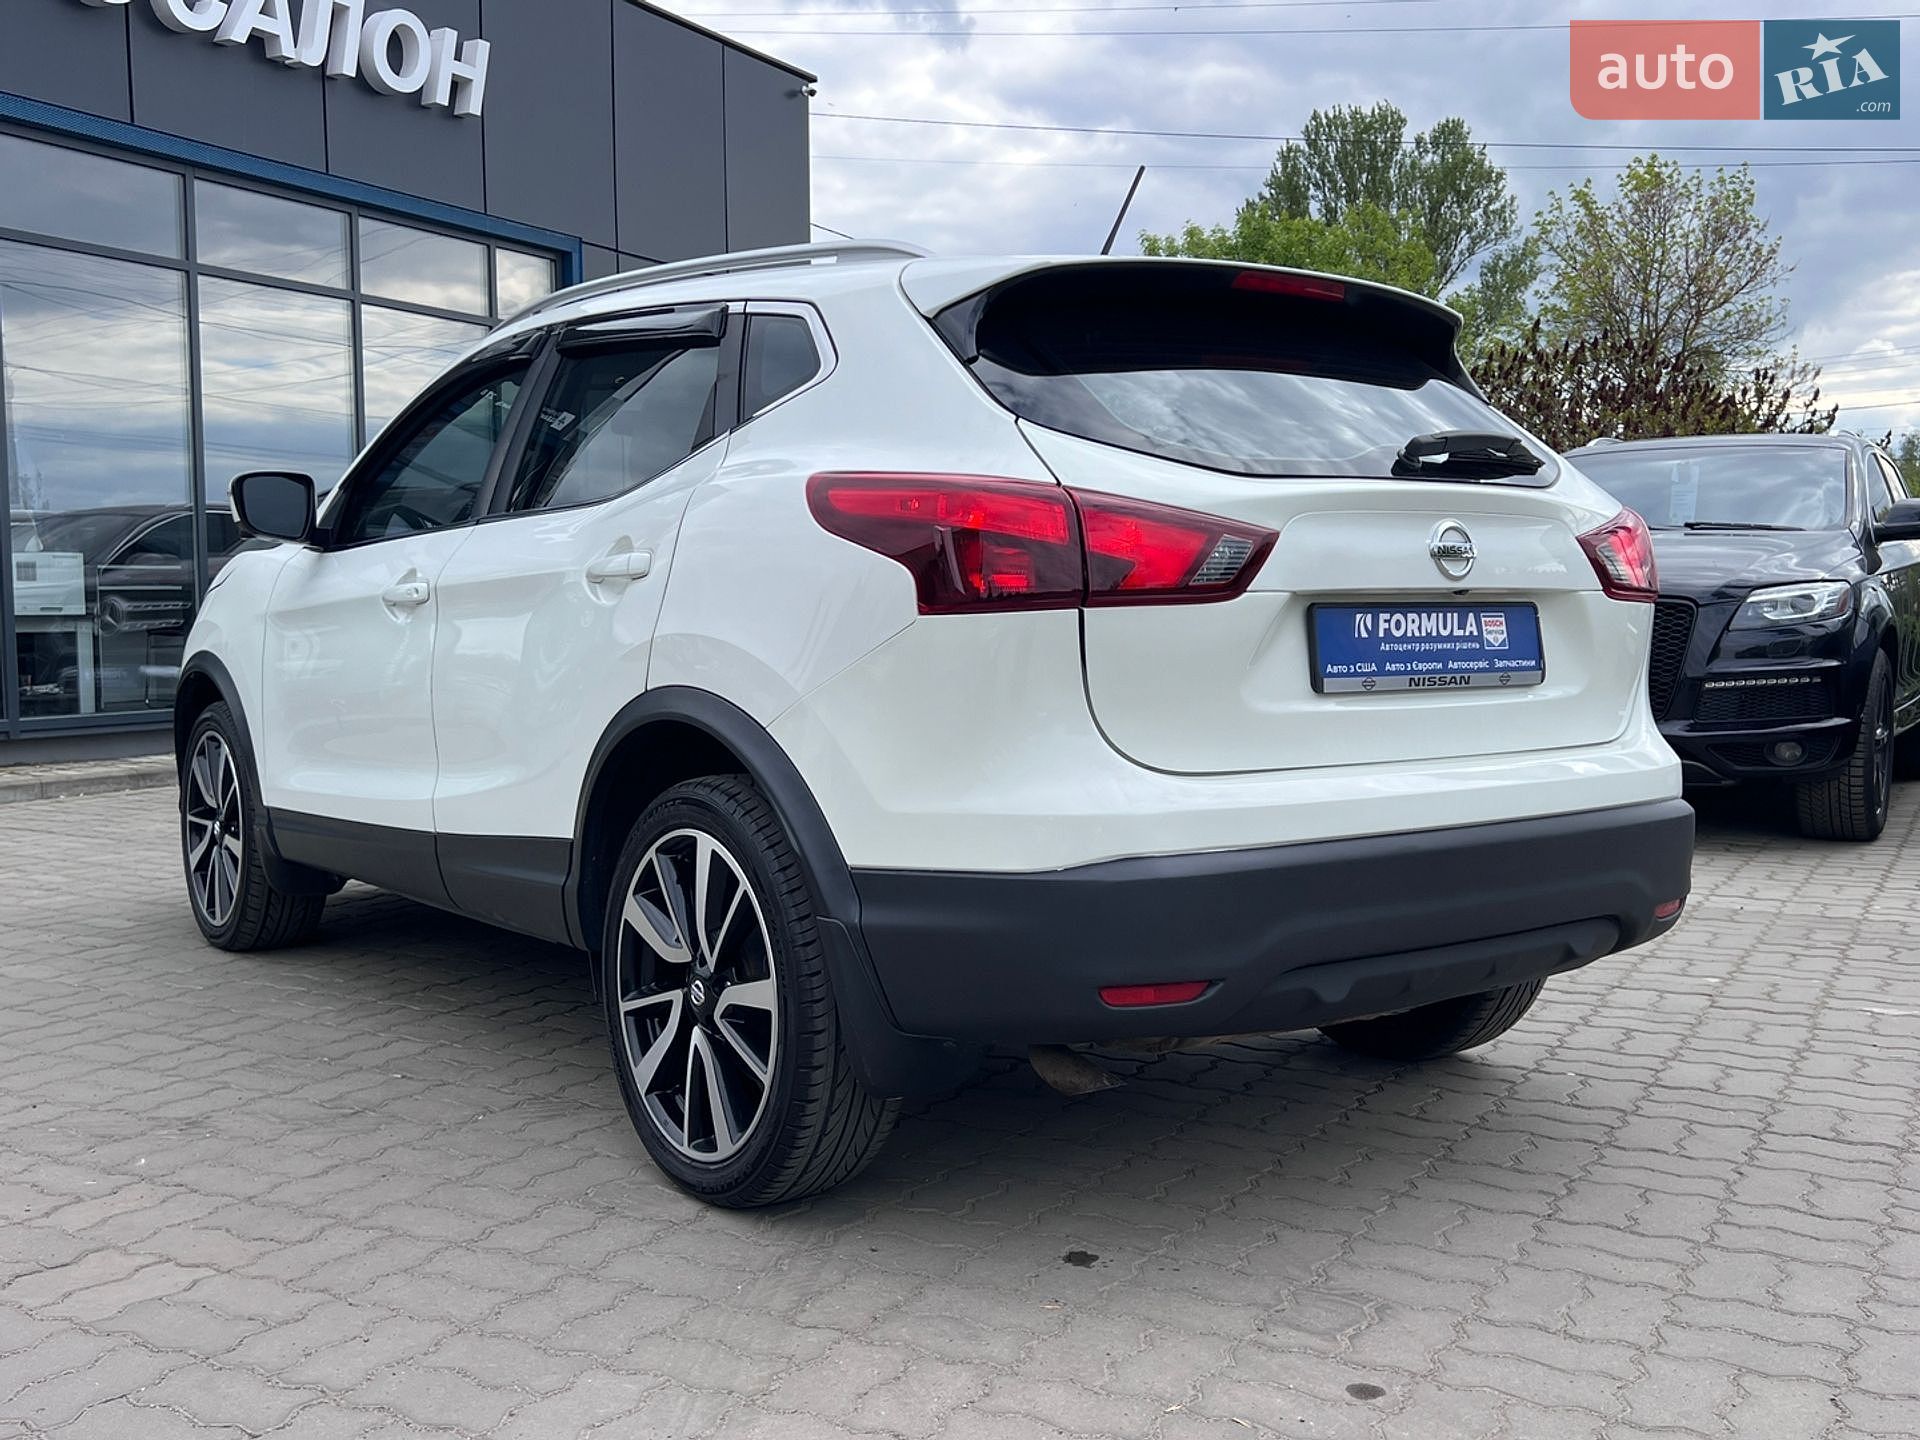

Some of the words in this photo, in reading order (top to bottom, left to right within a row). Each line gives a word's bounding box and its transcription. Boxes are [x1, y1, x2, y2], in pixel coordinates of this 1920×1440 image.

[1378, 612, 1479, 638] FORMULA
[1484, 619, 1504, 628] BOSCH
[1380, 642, 1420, 652] Автоцентр
[1421, 642, 1455, 652] розумних
[1455, 640, 1480, 651] рішень
[1326, 663, 1348, 674] Авто
[1356, 663, 1378, 673] США
[1385, 662, 1405, 672] Авто
[1413, 661, 1443, 672] Європи
[1448, 659, 1489, 670] Автосервіс
[1494, 658, 1536, 669] Запчастини
[1408, 676, 1471, 688] NISSAN
